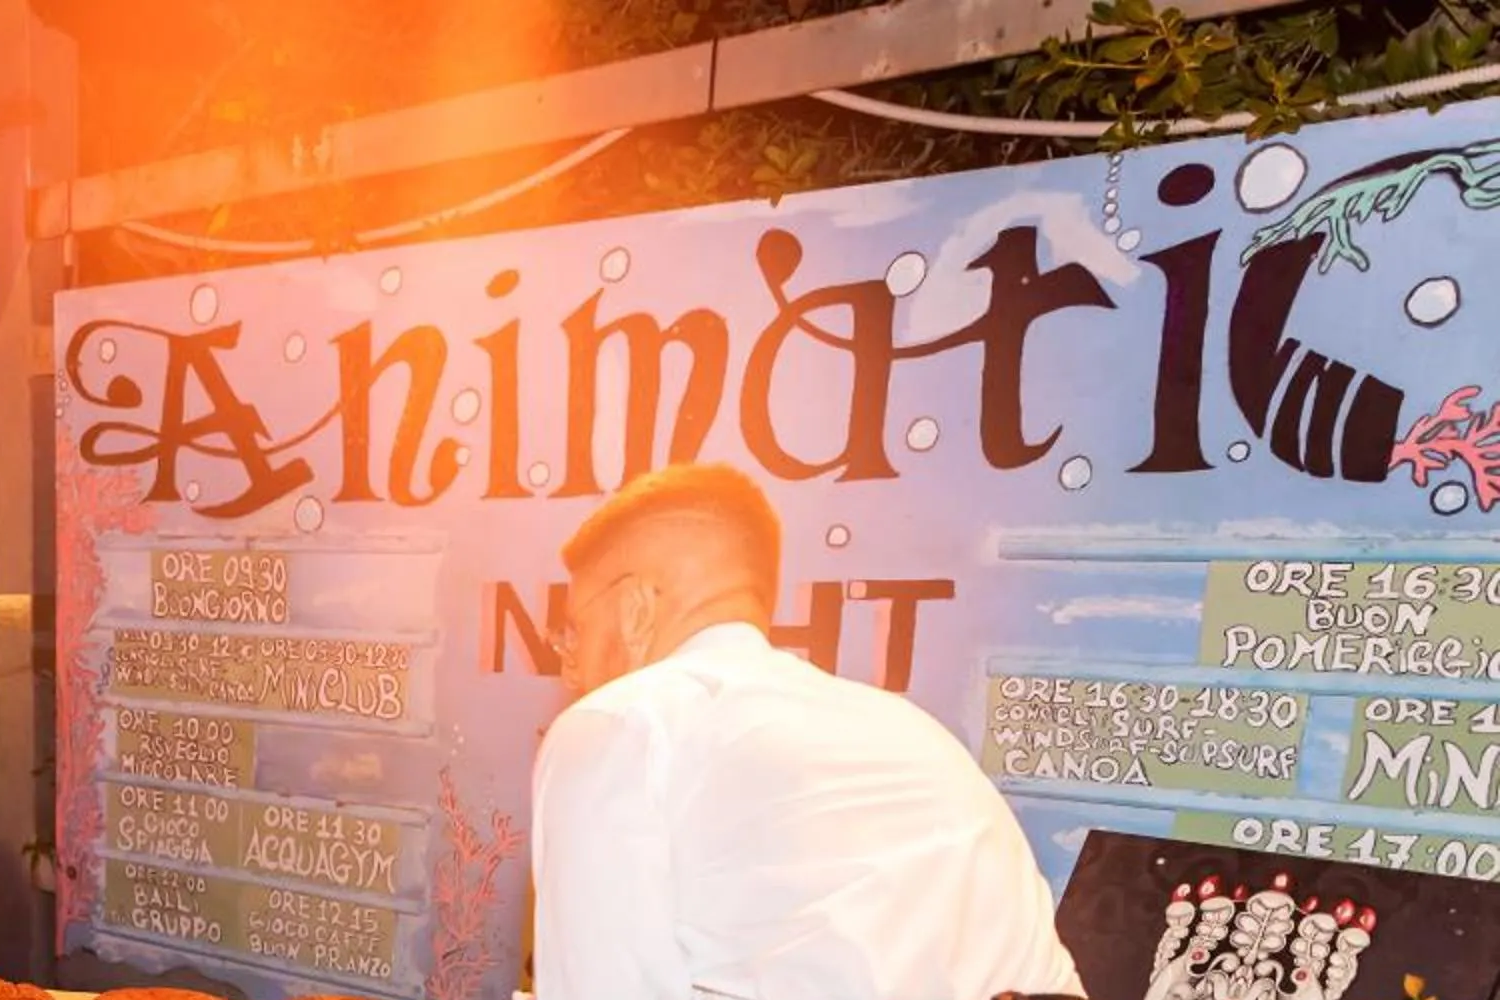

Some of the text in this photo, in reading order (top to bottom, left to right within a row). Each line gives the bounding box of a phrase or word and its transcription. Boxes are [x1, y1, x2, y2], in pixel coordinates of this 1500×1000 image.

[162, 551, 215, 583] ORE
[1245, 560, 1354, 599] ORE
[153, 581, 287, 624] BUONGIORNO
[1306, 597, 1438, 637] BUON
[261, 638, 300, 660] ORE
[481, 579, 955, 694] NHT
[1000, 676, 1075, 704] ORE
[119, 709, 160, 733] ORE
[1365, 697, 1458, 727] ORE
[1003, 749, 1152, 786] CANOA
[121, 785, 165, 811] ORE
[264, 804, 309, 833] ORE
[116, 815, 214, 865] SPIAGGIA
[1232, 817, 1336, 857] ORE
[243, 826, 397, 895] ACQUAGYM
[269, 890, 311, 919] ORE
[131, 907, 222, 943] GRUPPO
[250, 933, 392, 978] BUON PRANZO
